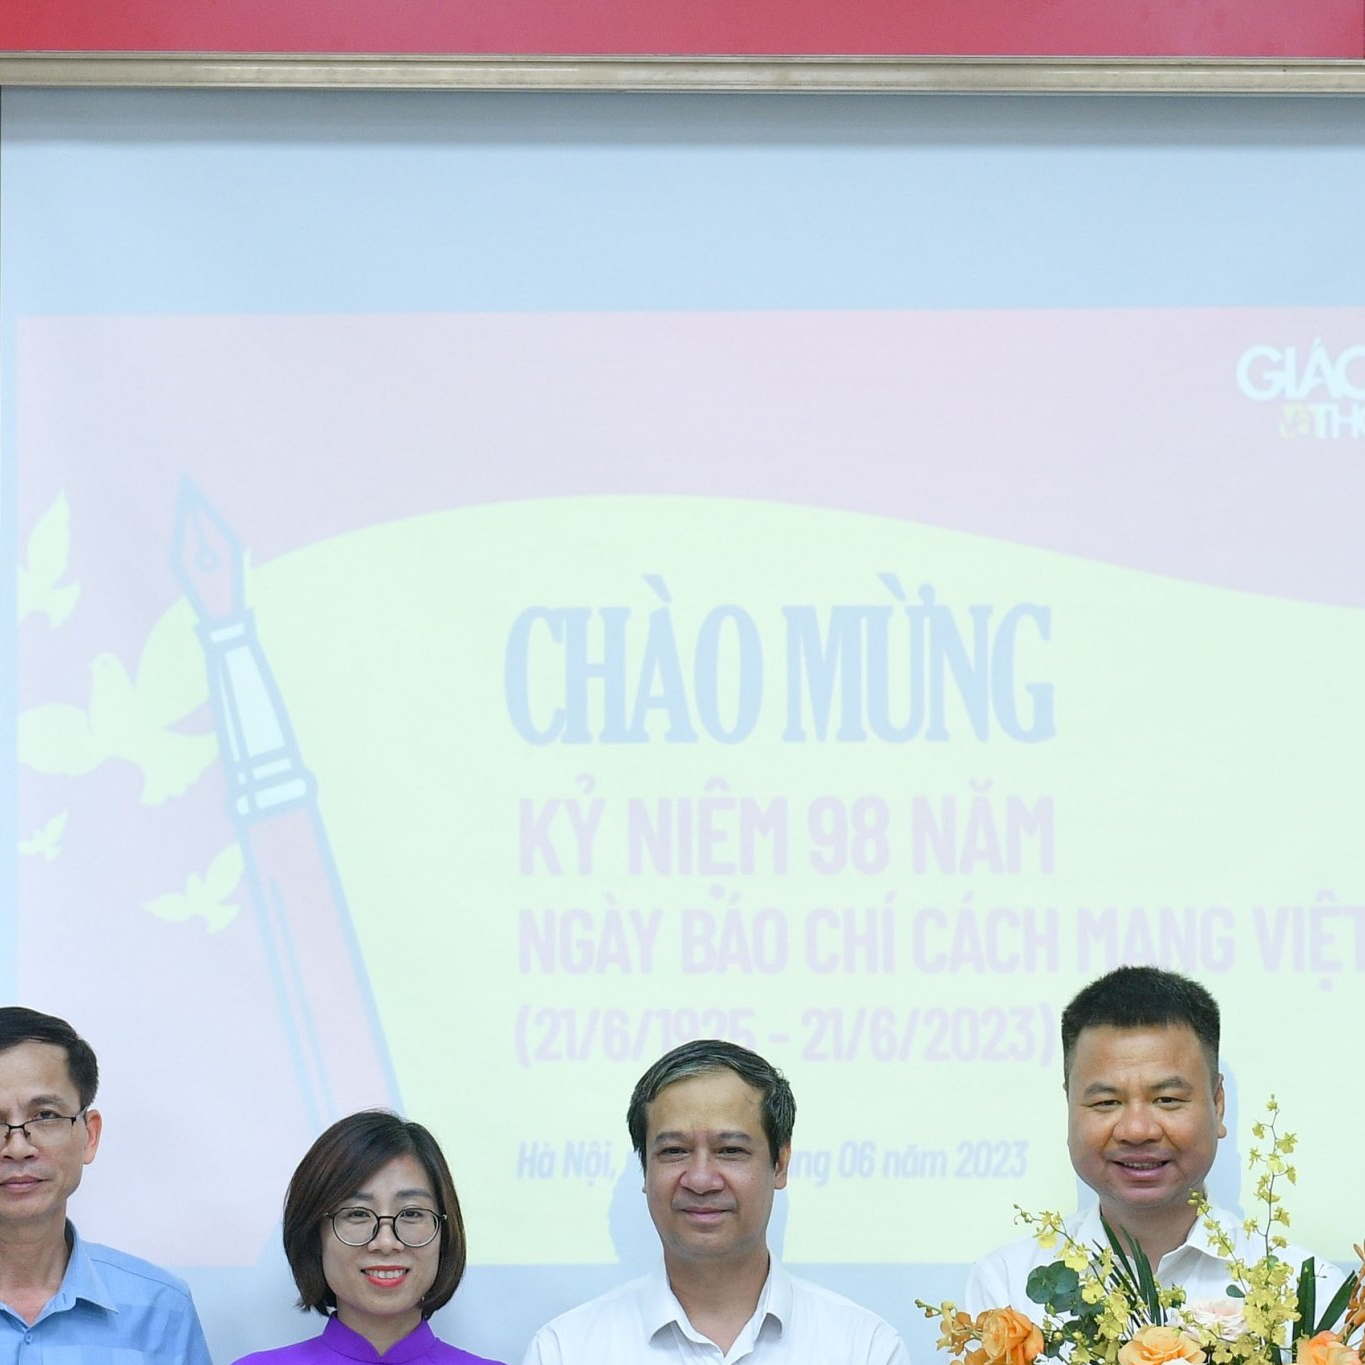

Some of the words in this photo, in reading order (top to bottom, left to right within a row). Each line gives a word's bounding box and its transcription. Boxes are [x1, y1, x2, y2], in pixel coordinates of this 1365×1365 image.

[504, 574, 763, 746] CHÀO
[782, 574, 1057, 746] MỪNG
[518, 773, 606, 877] KỶ
[627, 777, 789, 900] NIỆM
[807, 795, 891, 876] 98
[911, 778, 1055, 877] NĂM
[517, 891, 664, 976] NGÀY
[681, 891, 789, 976] BÁO
[805, 891, 898, 975] CHÍ
[912, 891, 1059, 975] CÁCH
[801, 1003, 1056, 1068] 21/6/2023)
[516, 1140, 556, 1180] Hà
[563, 1140, 618, 1188] Nội,
[838, 1141, 875, 1181] 06
[882, 1147, 948, 1180] năm
[955, 1140, 1030, 1181] 2023
